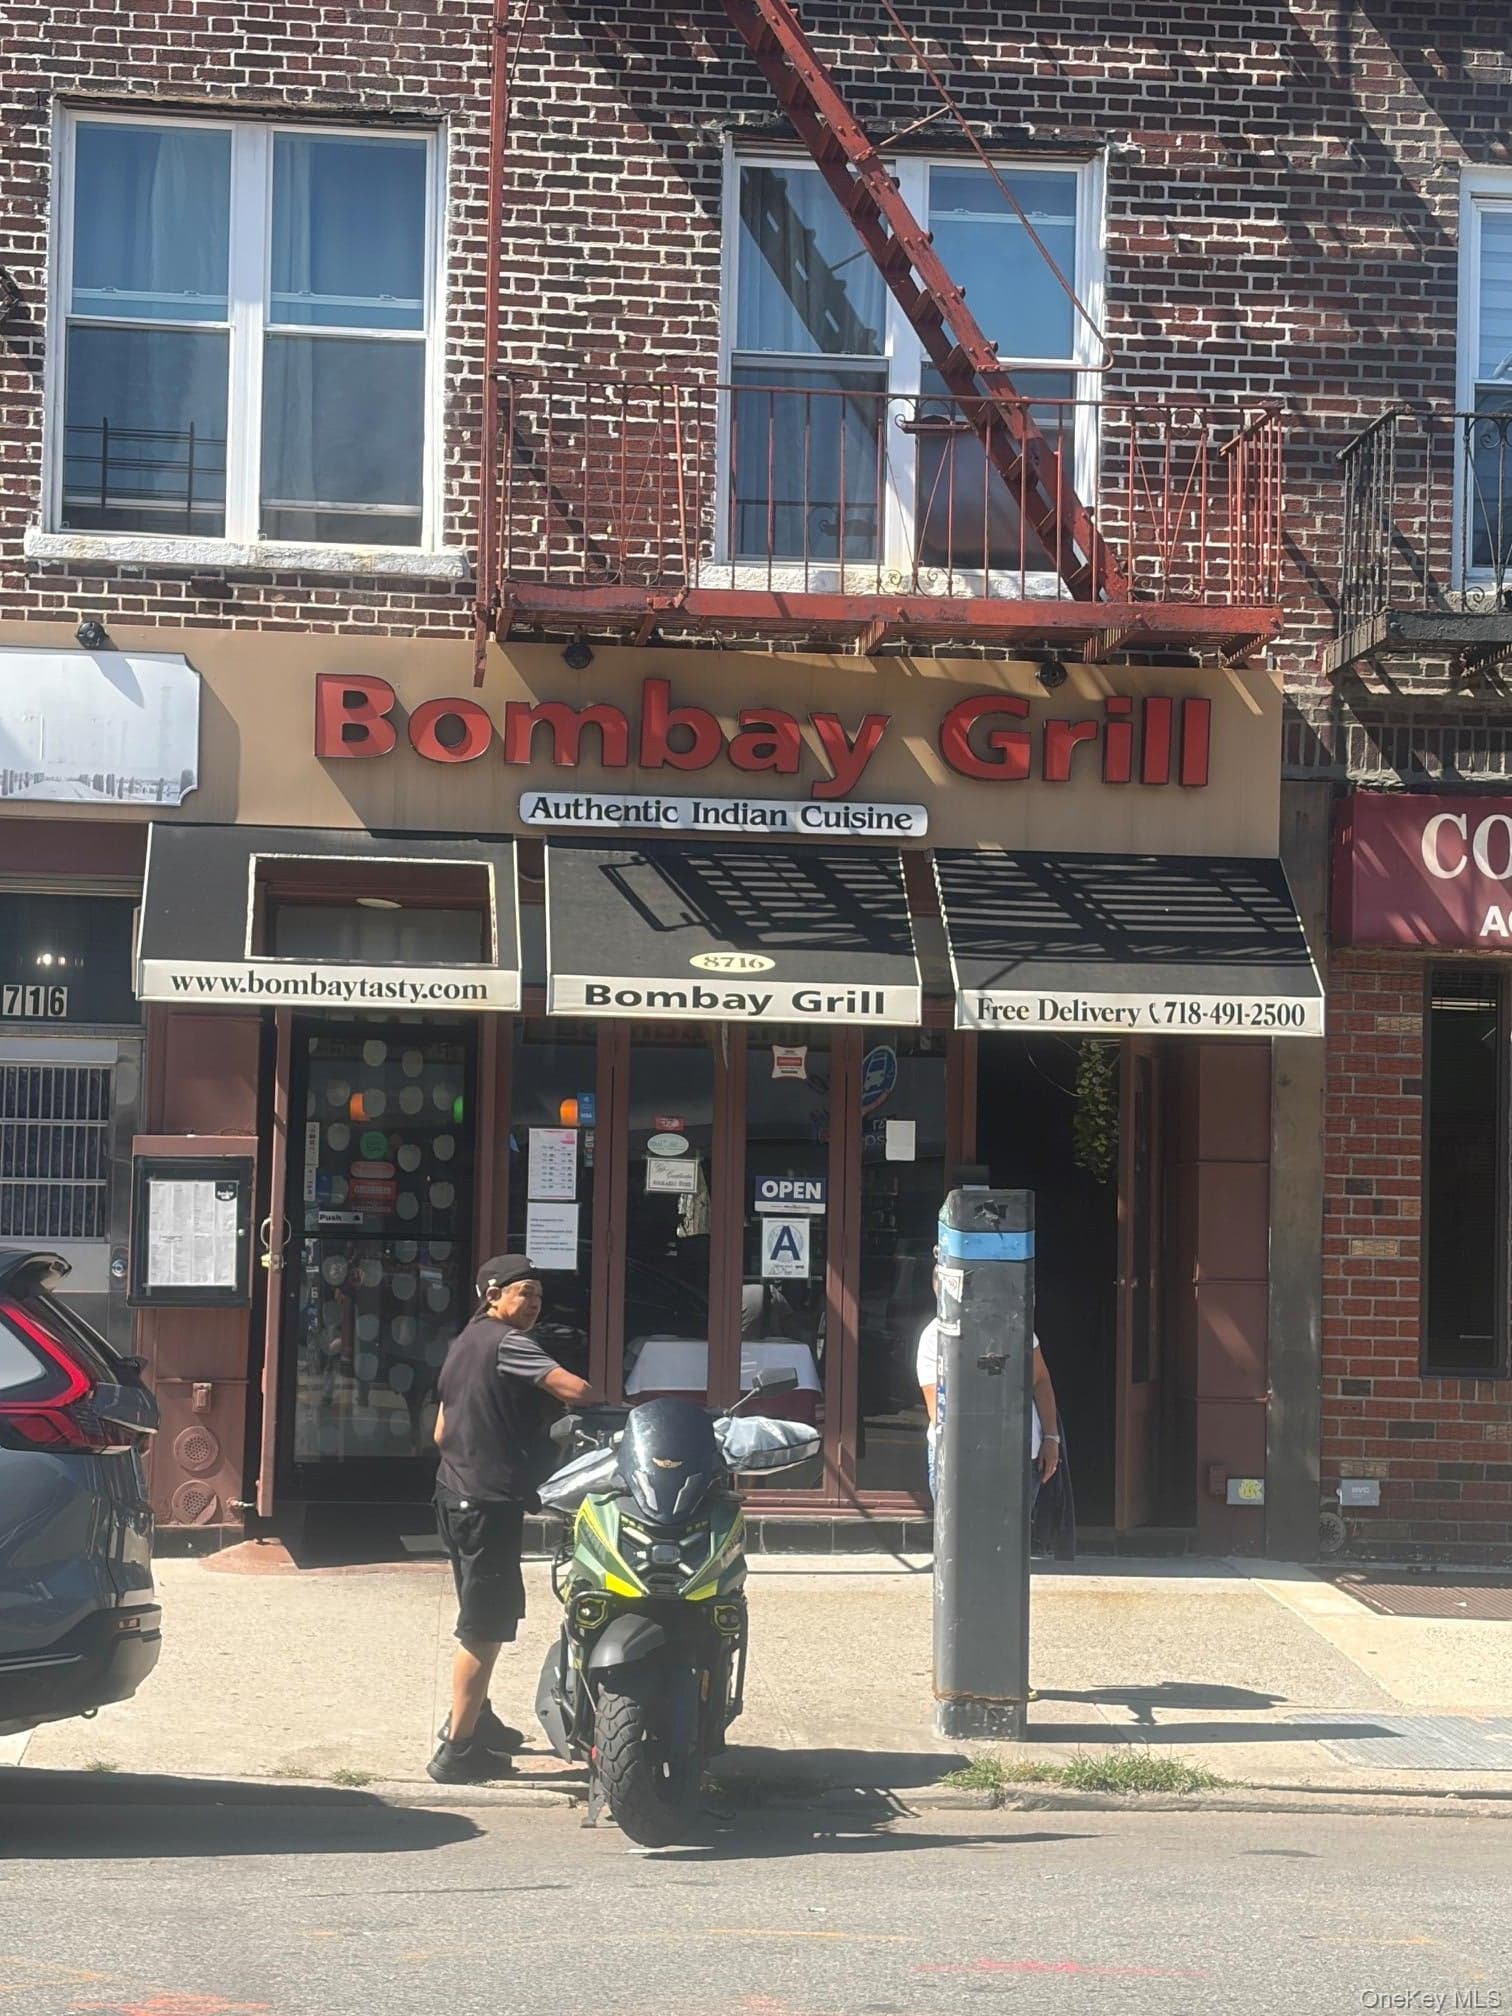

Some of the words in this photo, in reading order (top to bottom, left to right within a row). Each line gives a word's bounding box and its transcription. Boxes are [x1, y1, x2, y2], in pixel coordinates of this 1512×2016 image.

[315, 673, 891, 798] Bombay
[940, 696, 1211, 787] Grill
[528, 797, 678, 823] Authentic
[693, 801, 788, 827] Indian
[800, 806, 914, 831] Cuisine
[1479, 905, 1512, 937] A
[703, 955, 764, 969] 8716
[5, 986, 65, 1015] 716
[171, 970, 488, 1003] www.bombaytasty.com
[586, 984, 773, 1015] Bombay
[791, 990, 884, 1015] Grill
[977, 998, 1030, 1021] Free
[1037, 998, 1142, 1028] Delivery
[1163, 1001, 1306, 1027] 718-491-2500
[761, 1180, 822, 1199] OPEN
[770, 1226, 801, 1260] A
